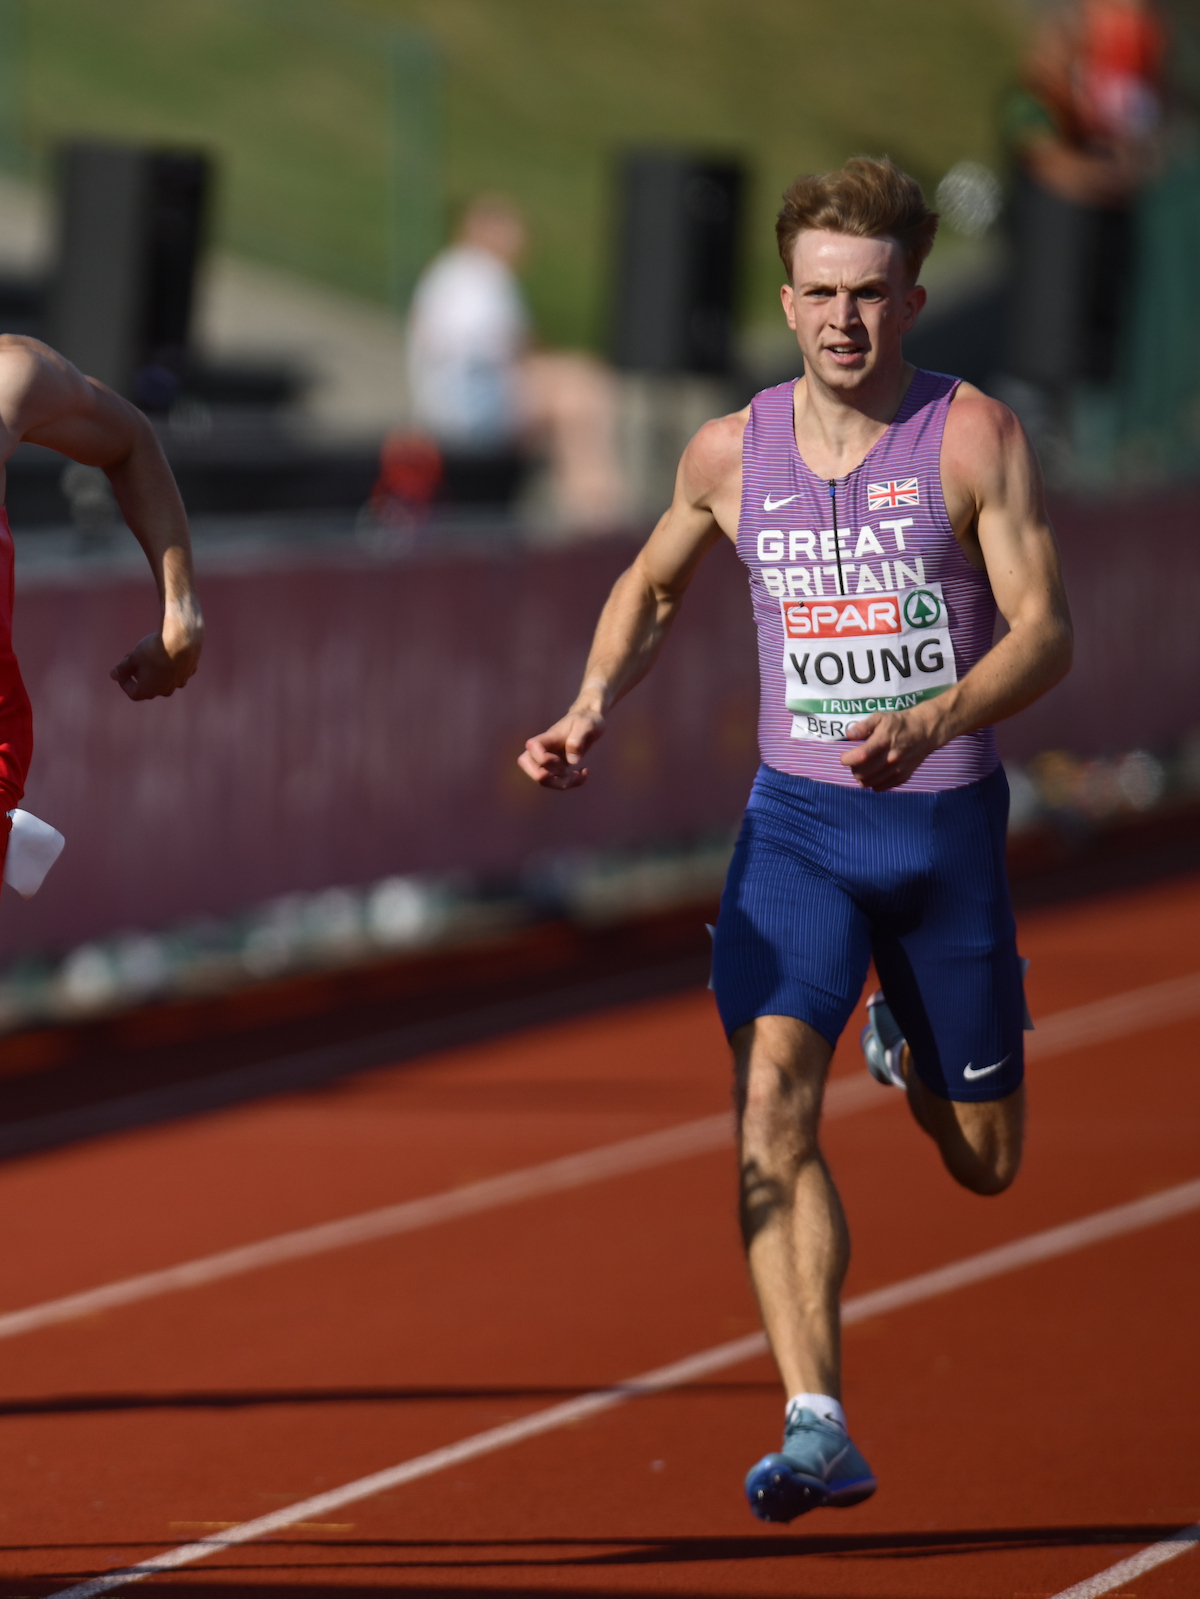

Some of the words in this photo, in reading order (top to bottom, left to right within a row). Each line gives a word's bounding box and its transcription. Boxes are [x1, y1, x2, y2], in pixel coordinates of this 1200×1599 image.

[757, 518, 913, 561] GREAT
[761, 557, 926, 597] BRITAIN
[787, 601, 898, 633] SPAR
[789, 638, 944, 685] YOUNG
[830, 700, 862, 713] RUN
[807, 716, 860, 737] BER
